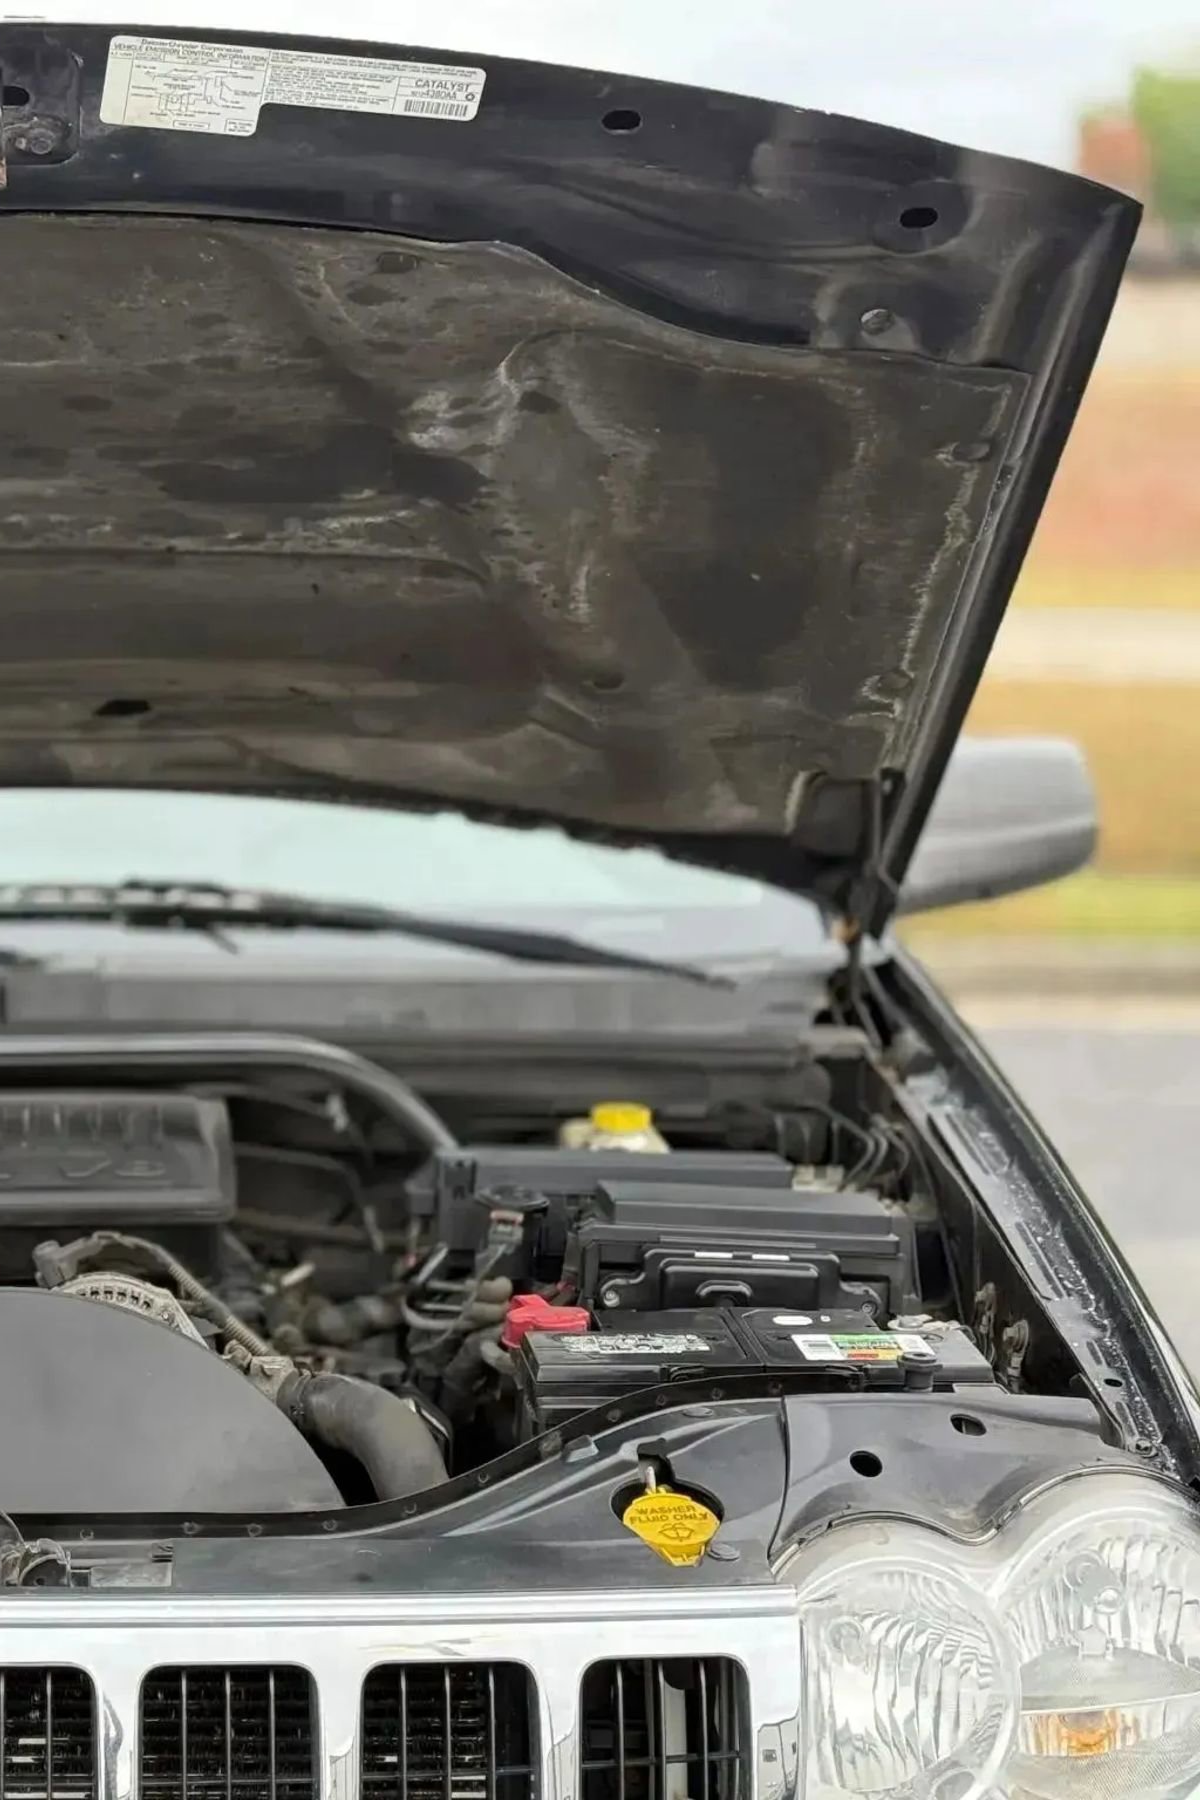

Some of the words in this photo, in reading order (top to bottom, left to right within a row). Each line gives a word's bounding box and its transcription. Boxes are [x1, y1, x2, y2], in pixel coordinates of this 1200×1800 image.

[114, 43, 142, 52] VEHICLE
[182, 49, 214, 58] CONTROL
[217, 53, 267, 62] INFORMATION
[415, 79, 469, 92] CATALYST
[635, 1505, 696, 1515] WASHER
[629, 1514, 669, 1525] FLUID
[673, 1511, 708, 1521] ONLY
